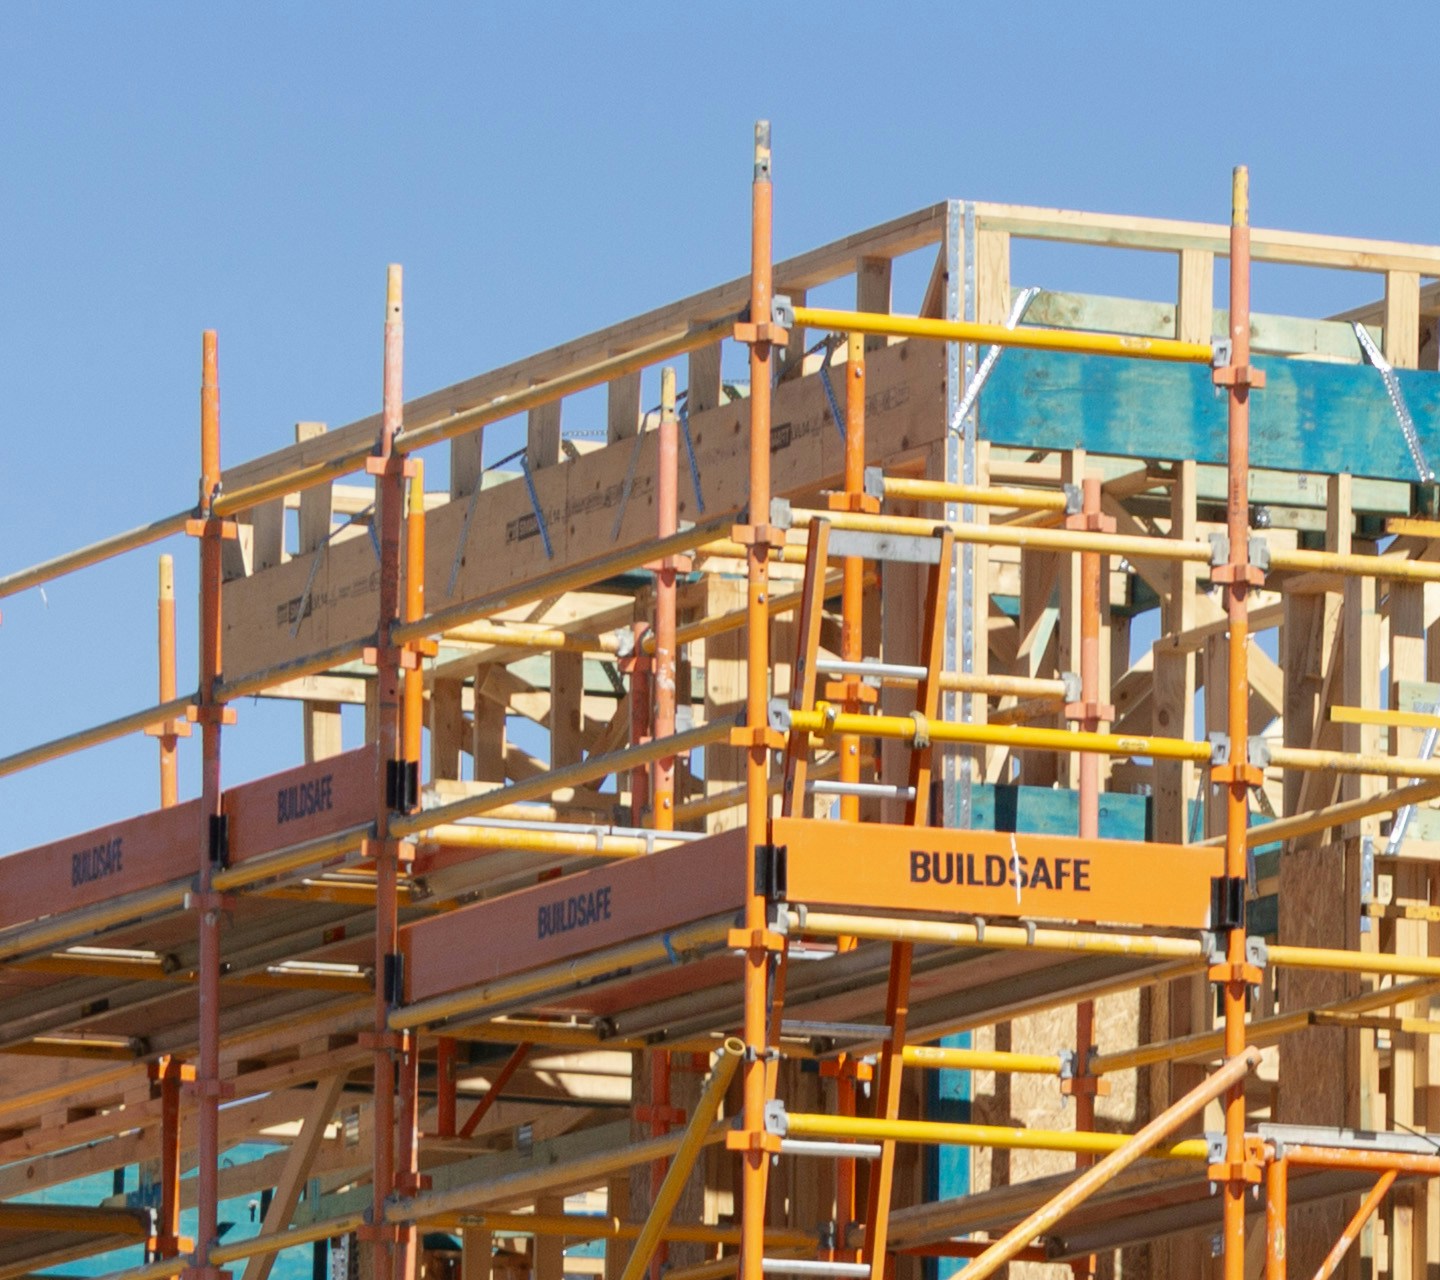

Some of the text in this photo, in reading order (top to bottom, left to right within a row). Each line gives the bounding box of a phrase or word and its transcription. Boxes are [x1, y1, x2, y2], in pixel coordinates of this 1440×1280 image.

[276, 774, 334, 824] BUILDSAFE
[71, 837, 124, 887] BUILDSAFE
[909, 850, 1091, 892] BUILDSAFE
[537, 885, 612, 940] BUILDSAFE
